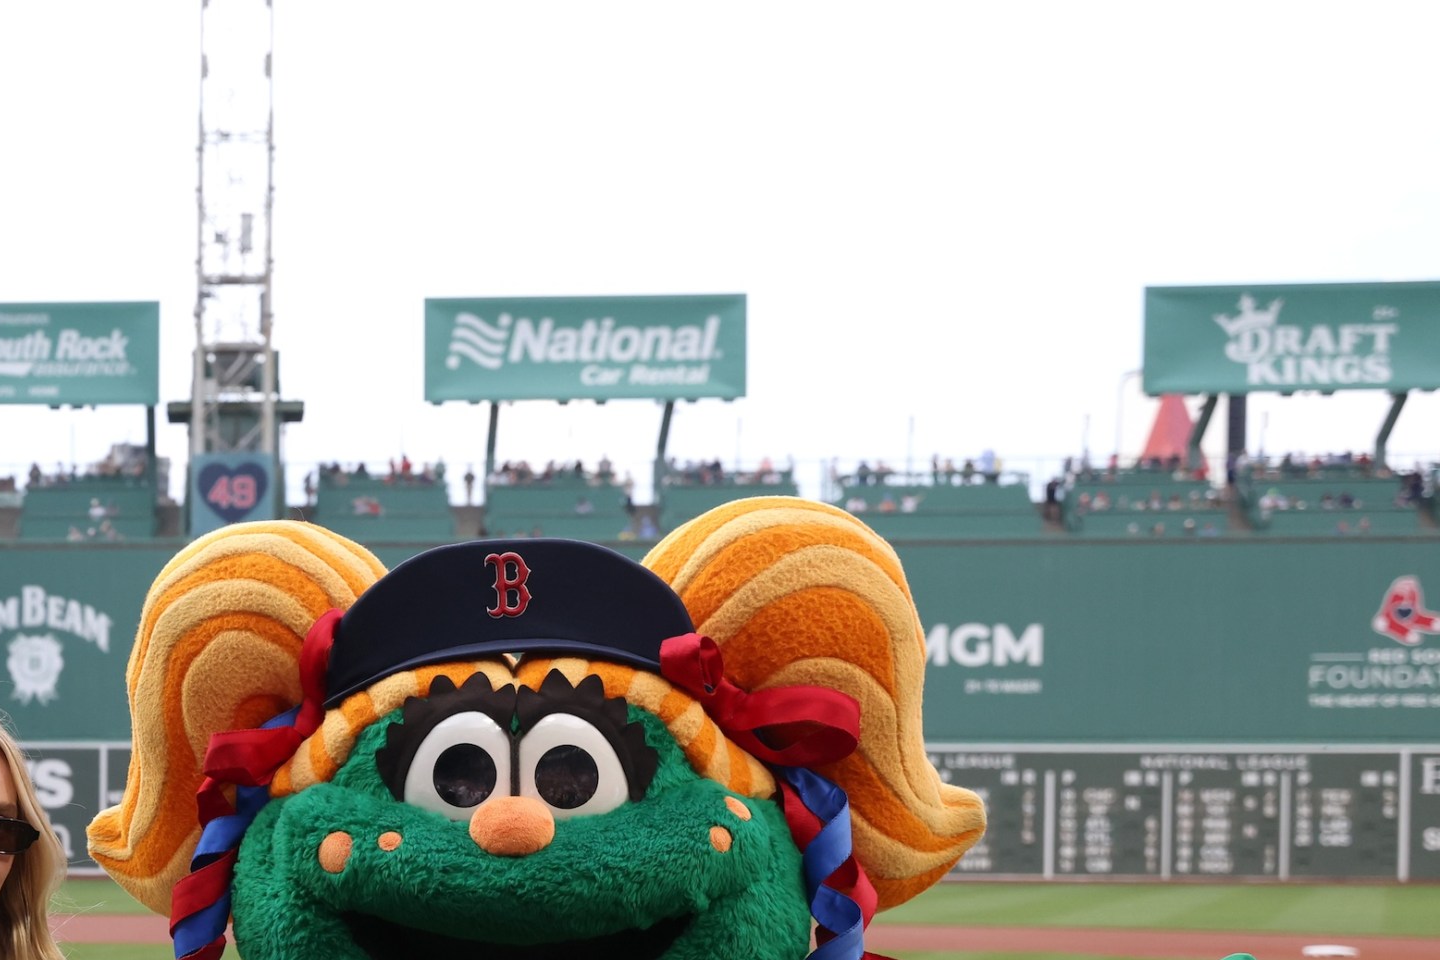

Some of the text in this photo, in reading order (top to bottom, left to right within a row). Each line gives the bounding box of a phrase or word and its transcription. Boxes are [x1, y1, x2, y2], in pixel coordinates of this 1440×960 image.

[57, 329, 129, 361] Rock
[508, 315, 721, 363] National
[1224, 324, 1399, 364] DRAFT
[580, 364, 709, 386] Car Rental
[1247, 354, 1393, 386] KINGS
[207, 474, 258, 510] 49
[484, 551, 533, 619] B
[21, 585, 112, 654] BEAM
[1140, 754, 1309, 771] NATIONAL LEAGUE
